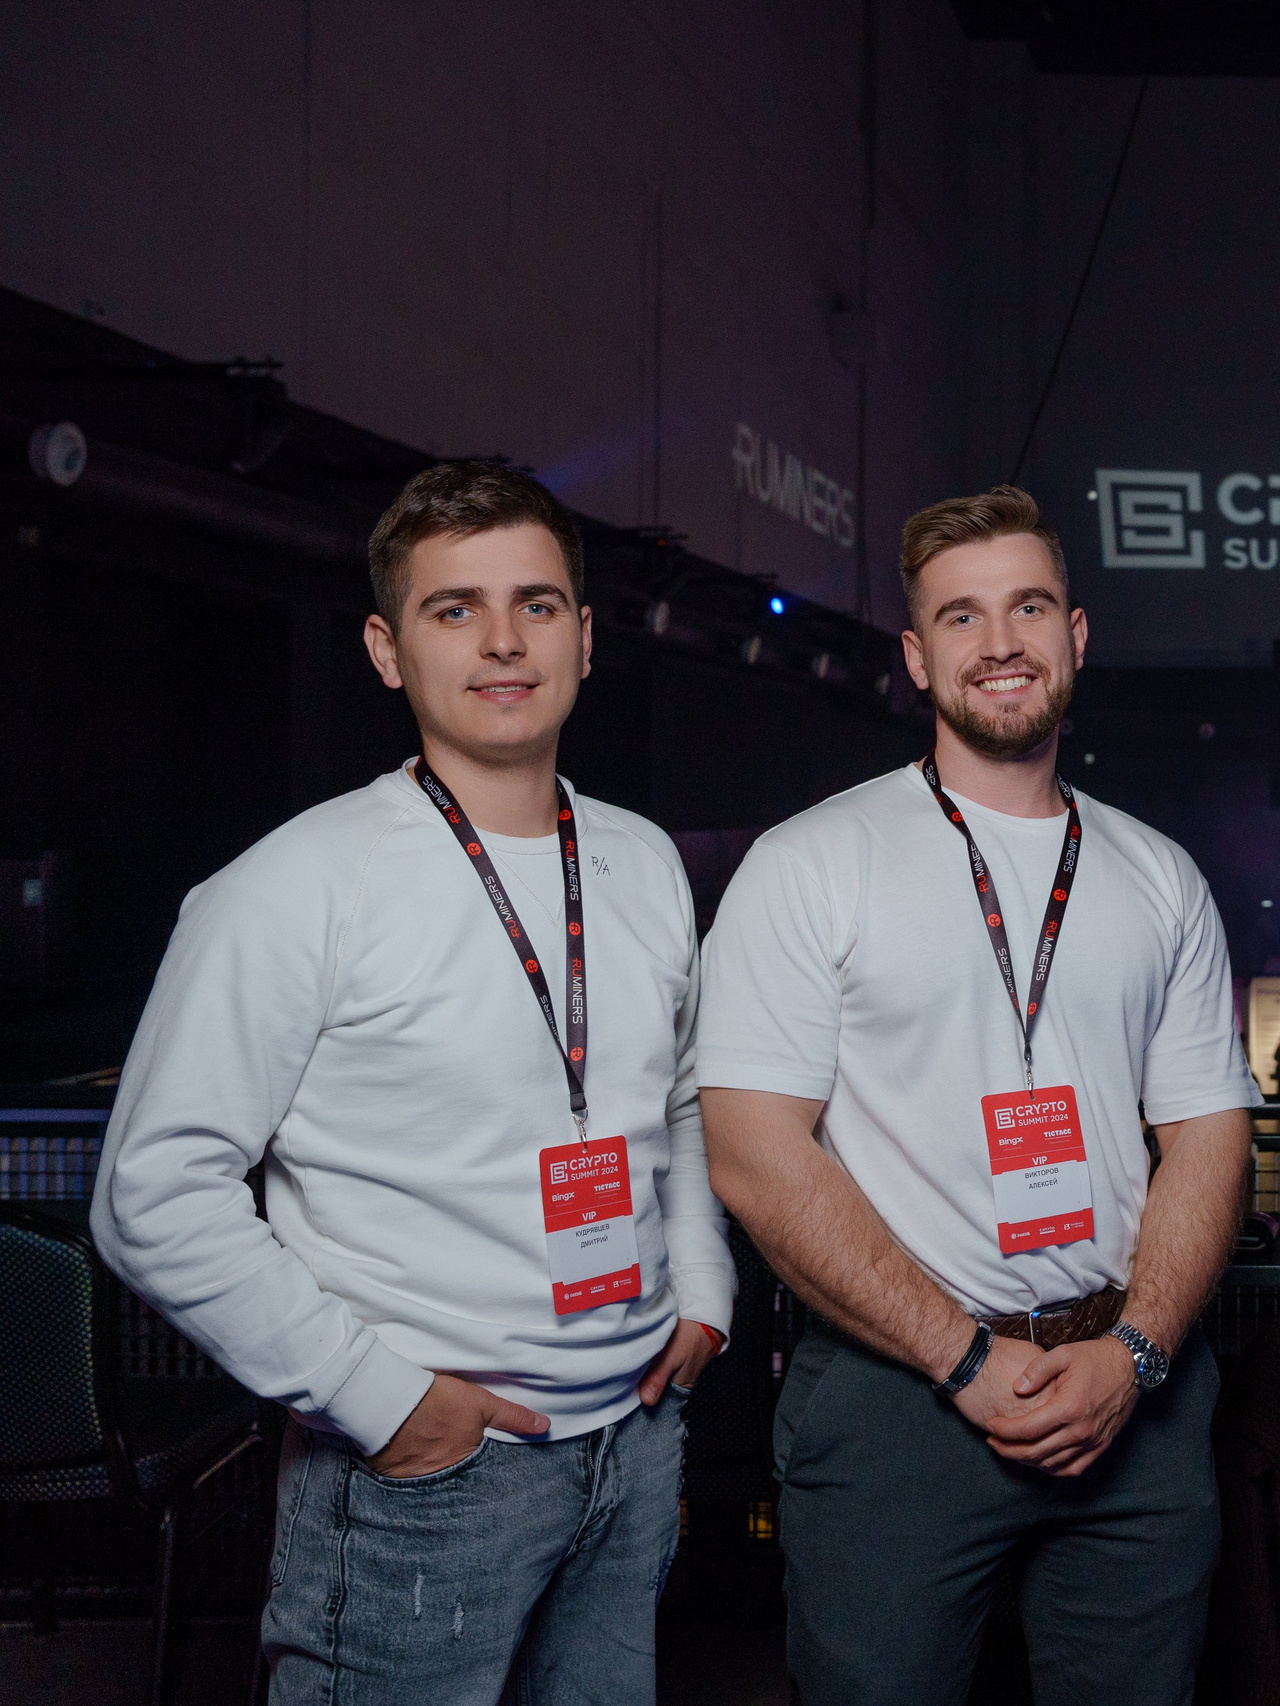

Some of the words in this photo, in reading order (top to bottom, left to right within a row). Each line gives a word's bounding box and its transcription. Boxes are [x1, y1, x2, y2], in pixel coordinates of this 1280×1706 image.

[422, 775, 461, 824] RUMINERS
[1063, 825, 1081, 873] RUMINERS
[565, 839, 579, 901] RUMINERS
[485, 875, 520, 938] RUMINERS
[1036, 920, 1057, 981] RUMINERS
[571, 957, 583, 1024] RUMINERS
[1016, 1100, 1067, 1117] CRYPTO
[1018, 1116, 1048, 1127] SUMMIT
[1050, 1113, 1068, 1122] 2024
[570, 1152, 618, 1170] CRYPTO
[1032, 1156, 1047, 1166] VIP
[571, 1168, 599, 1181] SUMMIT
[601, 1165, 618, 1175] 2024
[1025, 1167, 1059, 1179] ВИКТОРОВ
[1029, 1178, 1058, 1190] АЛЕКСЕЙ
[582, 1211, 597, 1221] VIP
[575, 1223, 610, 1238] КУДРЯВЦЕВ
[580, 1234, 609, 1249] ДМИТРИЙ
